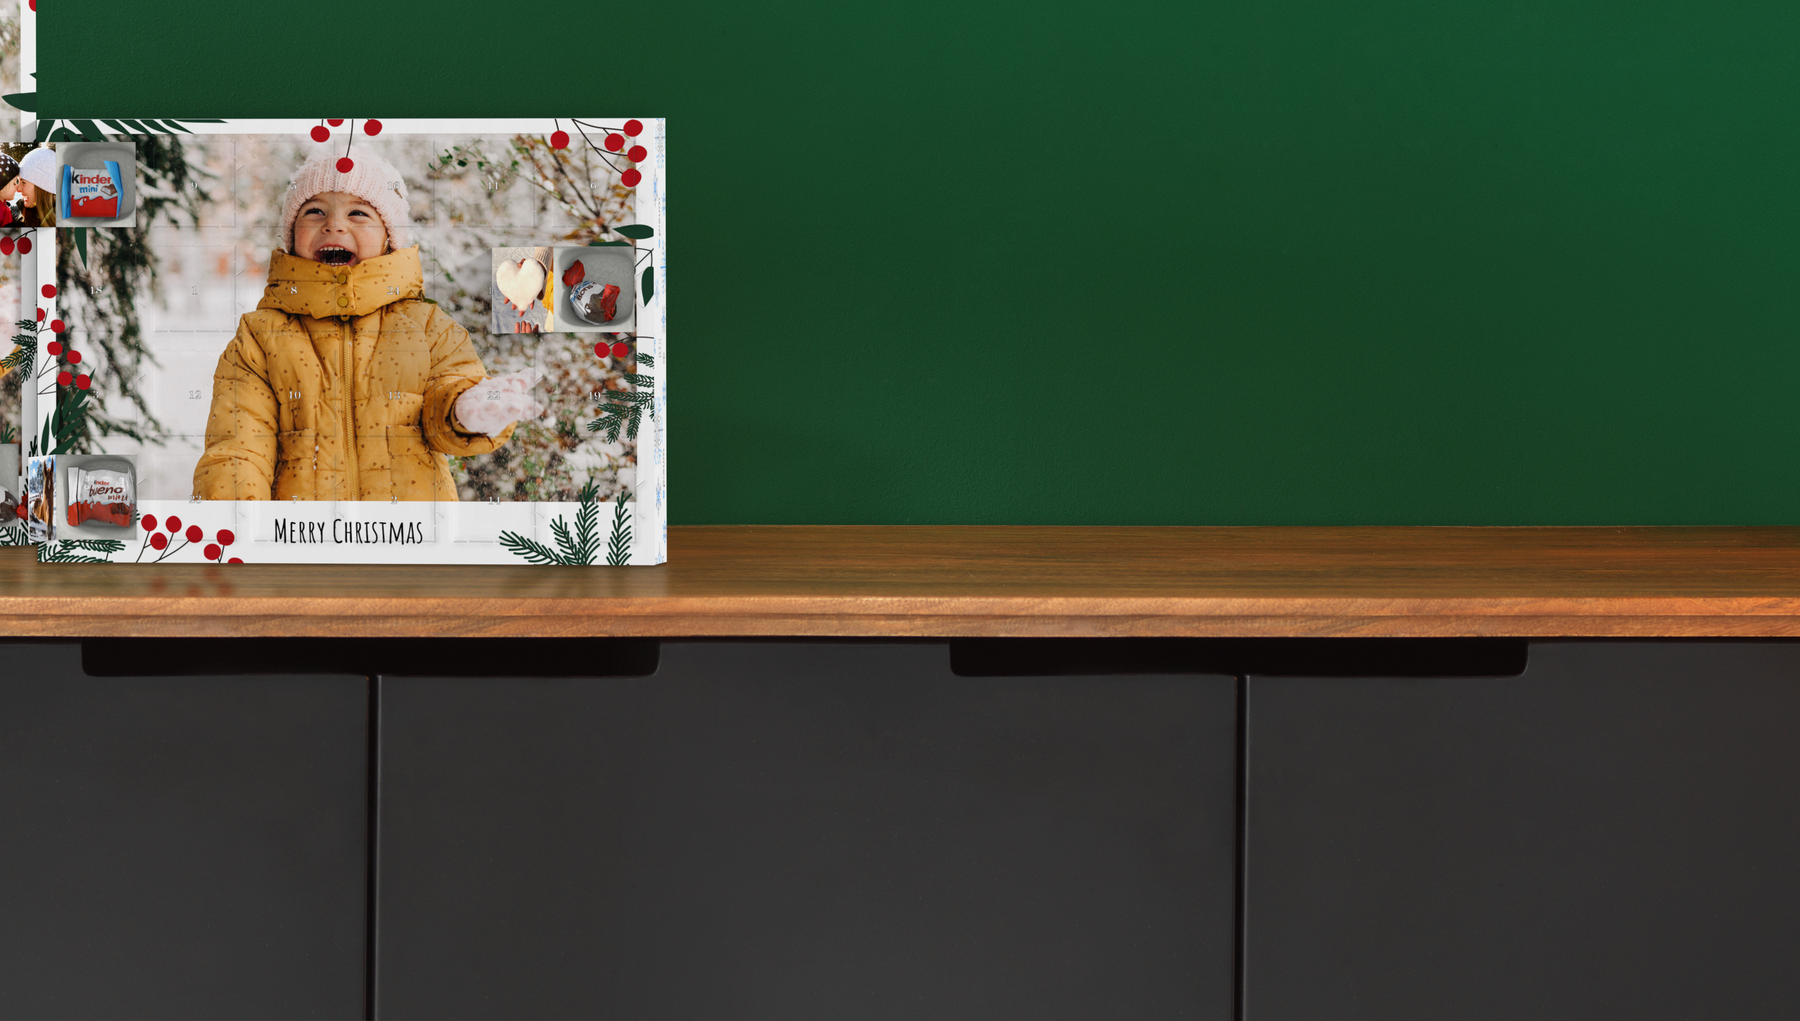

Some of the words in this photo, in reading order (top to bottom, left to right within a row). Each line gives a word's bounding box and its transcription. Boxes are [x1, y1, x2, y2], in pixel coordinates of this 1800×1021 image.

[79, 184, 99, 193] mini
[191, 181, 198, 190] 9
[290, 181, 297, 190] 5
[387, 181, 401, 191] 16
[590, 181, 597, 190] 6
[90, 286, 103, 295] 18
[191, 285, 198, 295] 1
[290, 286, 298, 295] 8
[386, 285, 401, 295] 24
[188, 390, 202, 400] 12
[288, 390, 301, 400] 10
[388, 390, 401, 400] 13
[487, 390, 501, 400] 22
[588, 391, 601, 401] 19
[188, 494, 202, 504] 23
[291, 495, 298, 504] 7
[390, 495, 398, 505] 2
